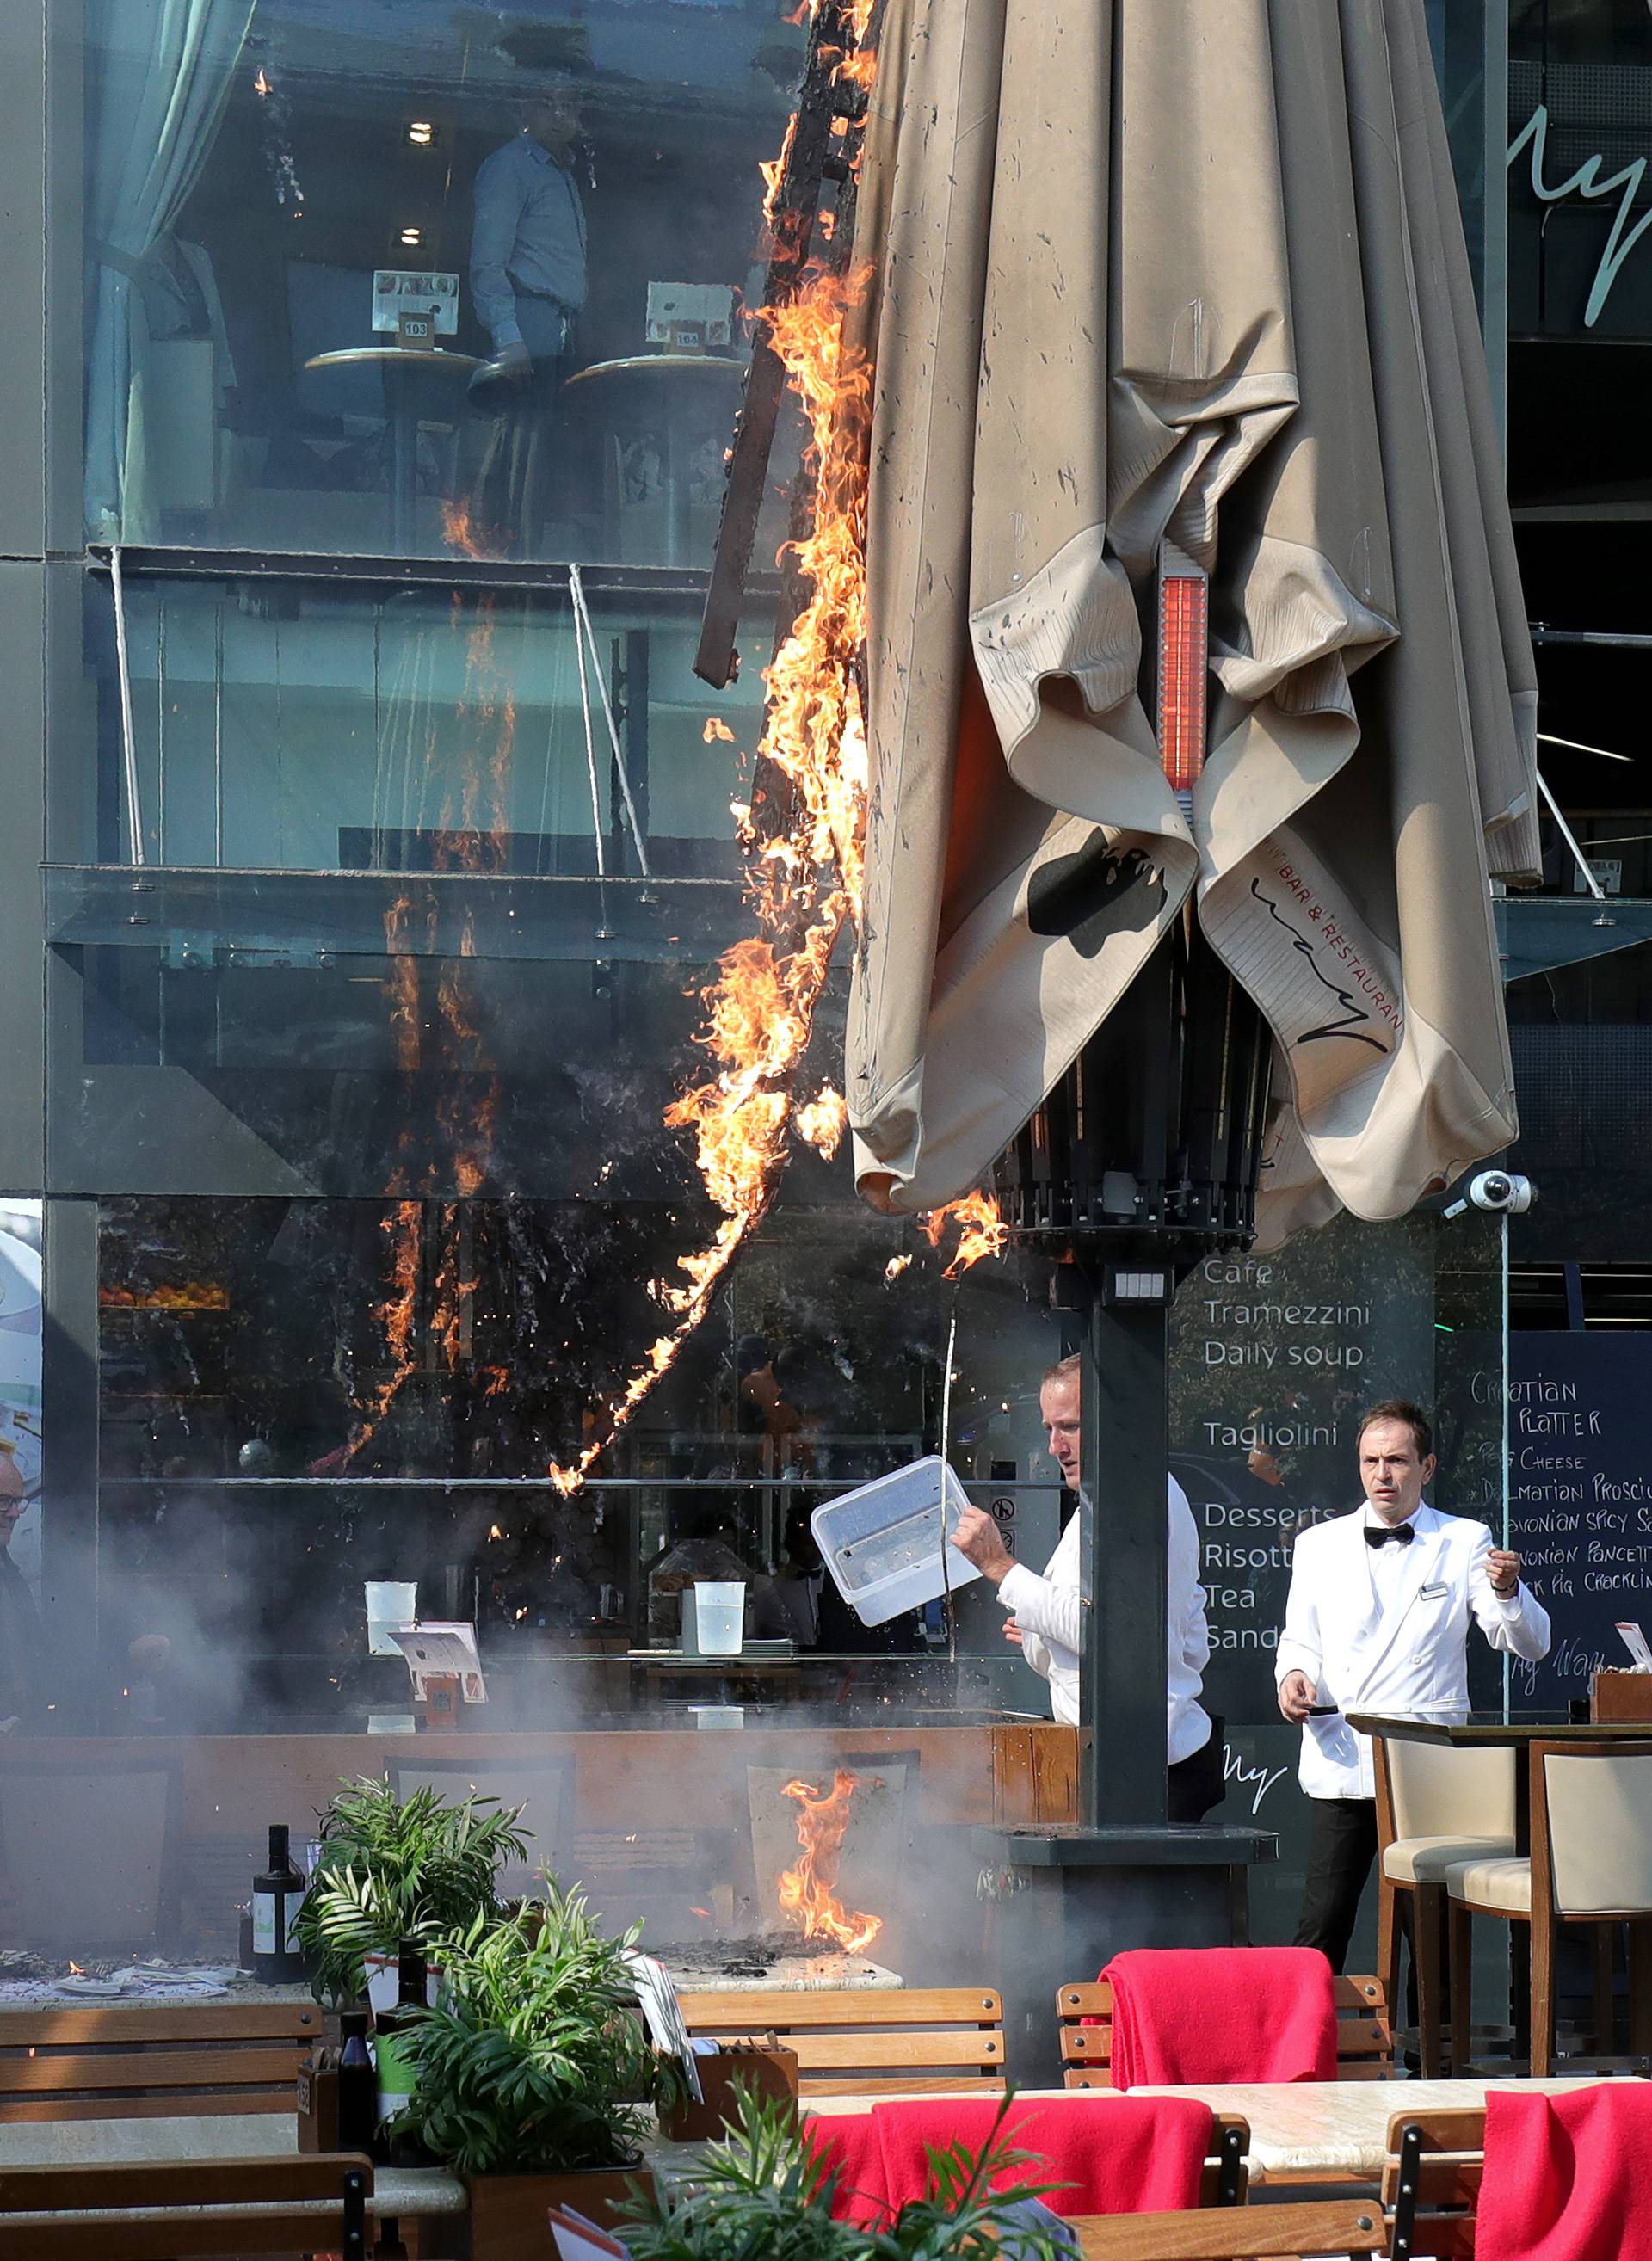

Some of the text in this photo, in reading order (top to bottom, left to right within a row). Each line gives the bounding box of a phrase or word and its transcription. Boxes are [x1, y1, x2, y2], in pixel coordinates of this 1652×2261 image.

[406, 323, 427, 335] 103
[1279, 864, 1310, 903] BAR
[1307, 905, 1322, 922] &
[1204, 1260, 1273, 1284] Cafe
[1204, 1300, 1371, 1325] Tramezzini
[1205, 1340, 1364, 1370] Daily soup
[1204, 1421, 1337, 1451] Tagliolini
[1519, 1445, 1587, 1470] CHEESE
[1205, 1503, 1337, 1528] Desserts
[1205, 1543, 1292, 1568] Risott
[1204, 1584, 1255, 1609] Tea
[1206, 1624, 1279, 1649] Sand
